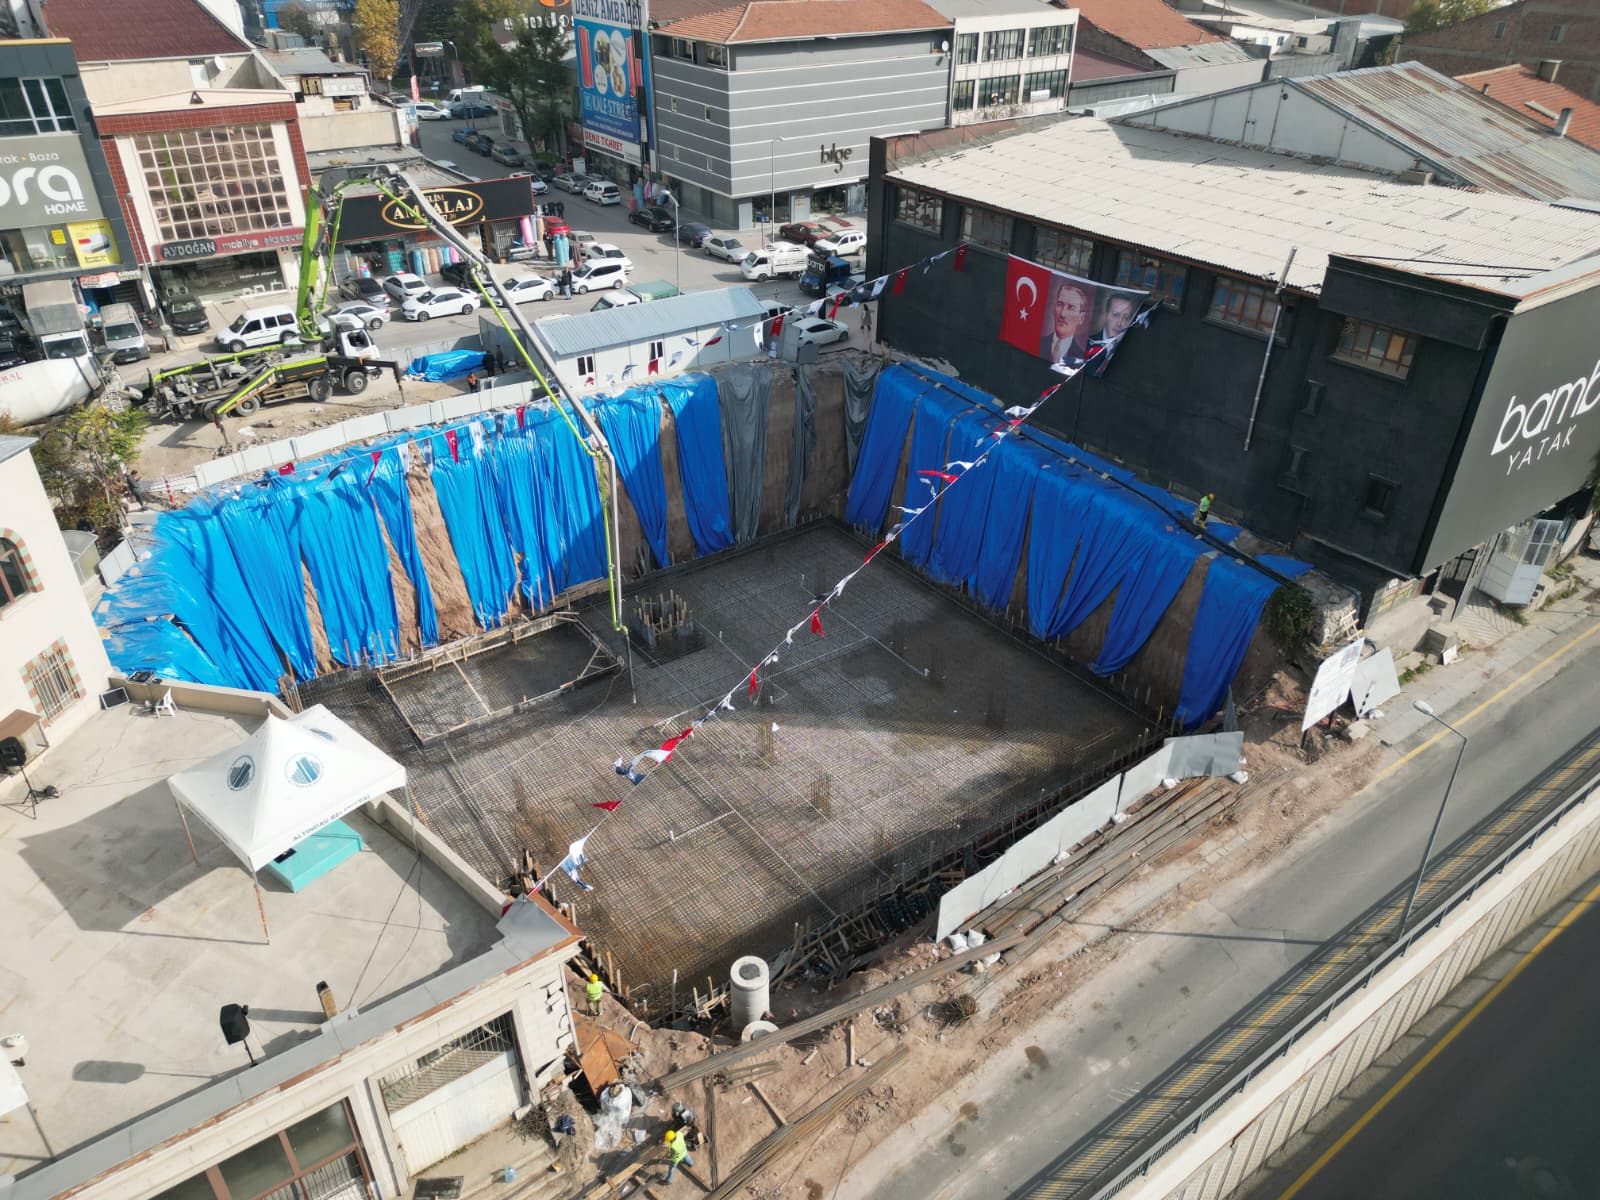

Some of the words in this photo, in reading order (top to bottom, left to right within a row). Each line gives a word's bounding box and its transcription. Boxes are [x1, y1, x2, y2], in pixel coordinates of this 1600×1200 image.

[29, 152, 60, 162] Baza
[820, 143, 852, 173] bilge
[44, 201, 88, 215] HOME
[163, 241, 216, 258] AYDOĞAN
[222, 239, 259, 250] mobilya
[1506, 424, 1577, 476] YATAK
